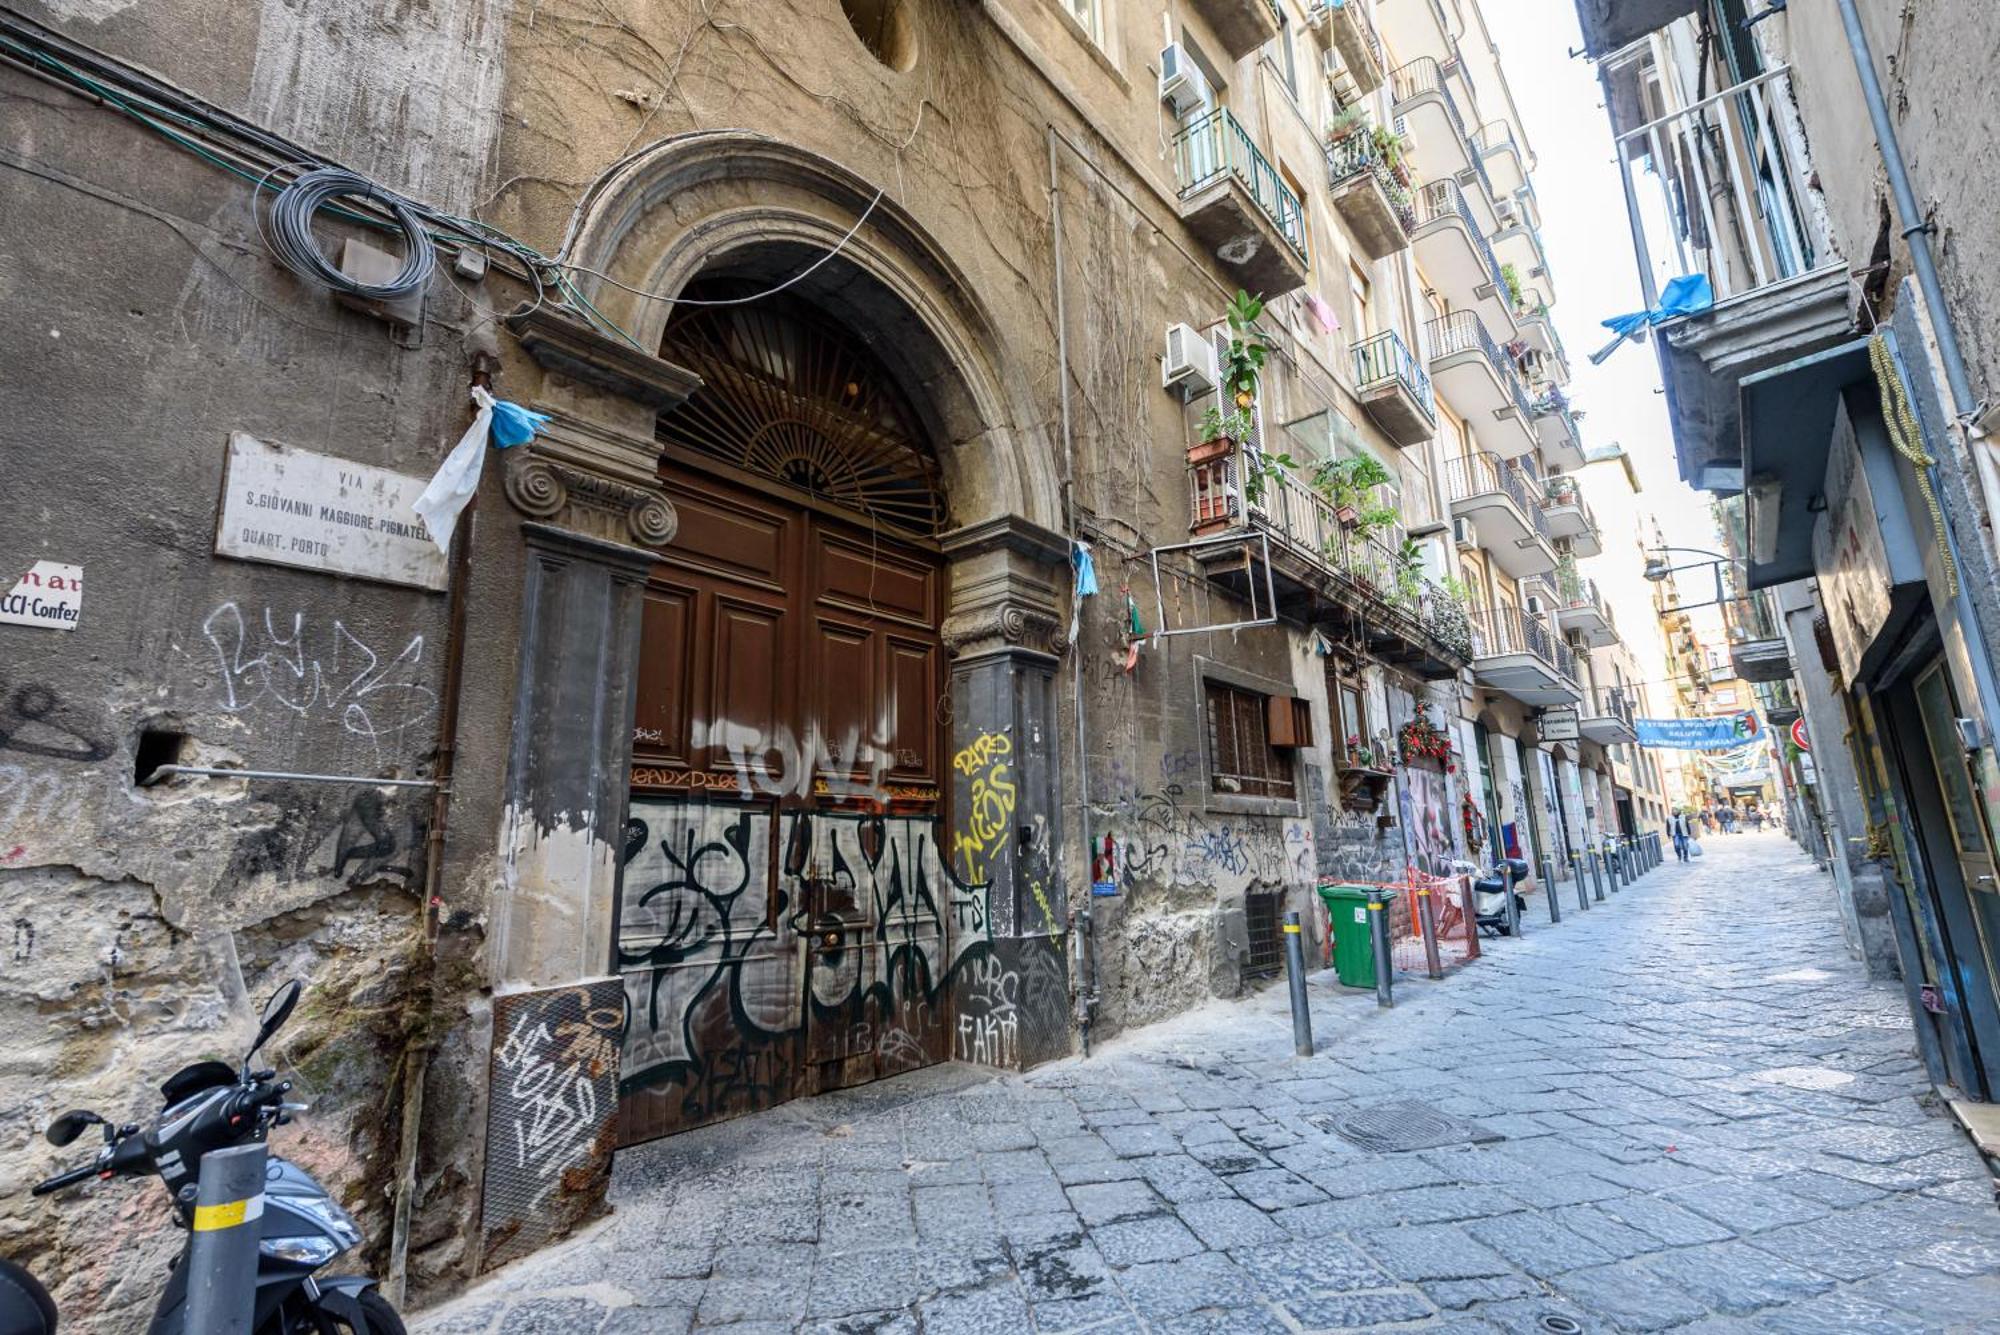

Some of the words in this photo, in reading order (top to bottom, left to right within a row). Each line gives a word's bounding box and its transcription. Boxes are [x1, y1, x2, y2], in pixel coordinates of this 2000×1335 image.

[338, 470, 363, 490] VIA
[319, 505, 374, 531] MAGGIORE
[379, 518, 435, 543] PIGNATELL
[241, 526, 286, 551] QUART.
[290, 536, 329, 558] PORTO
